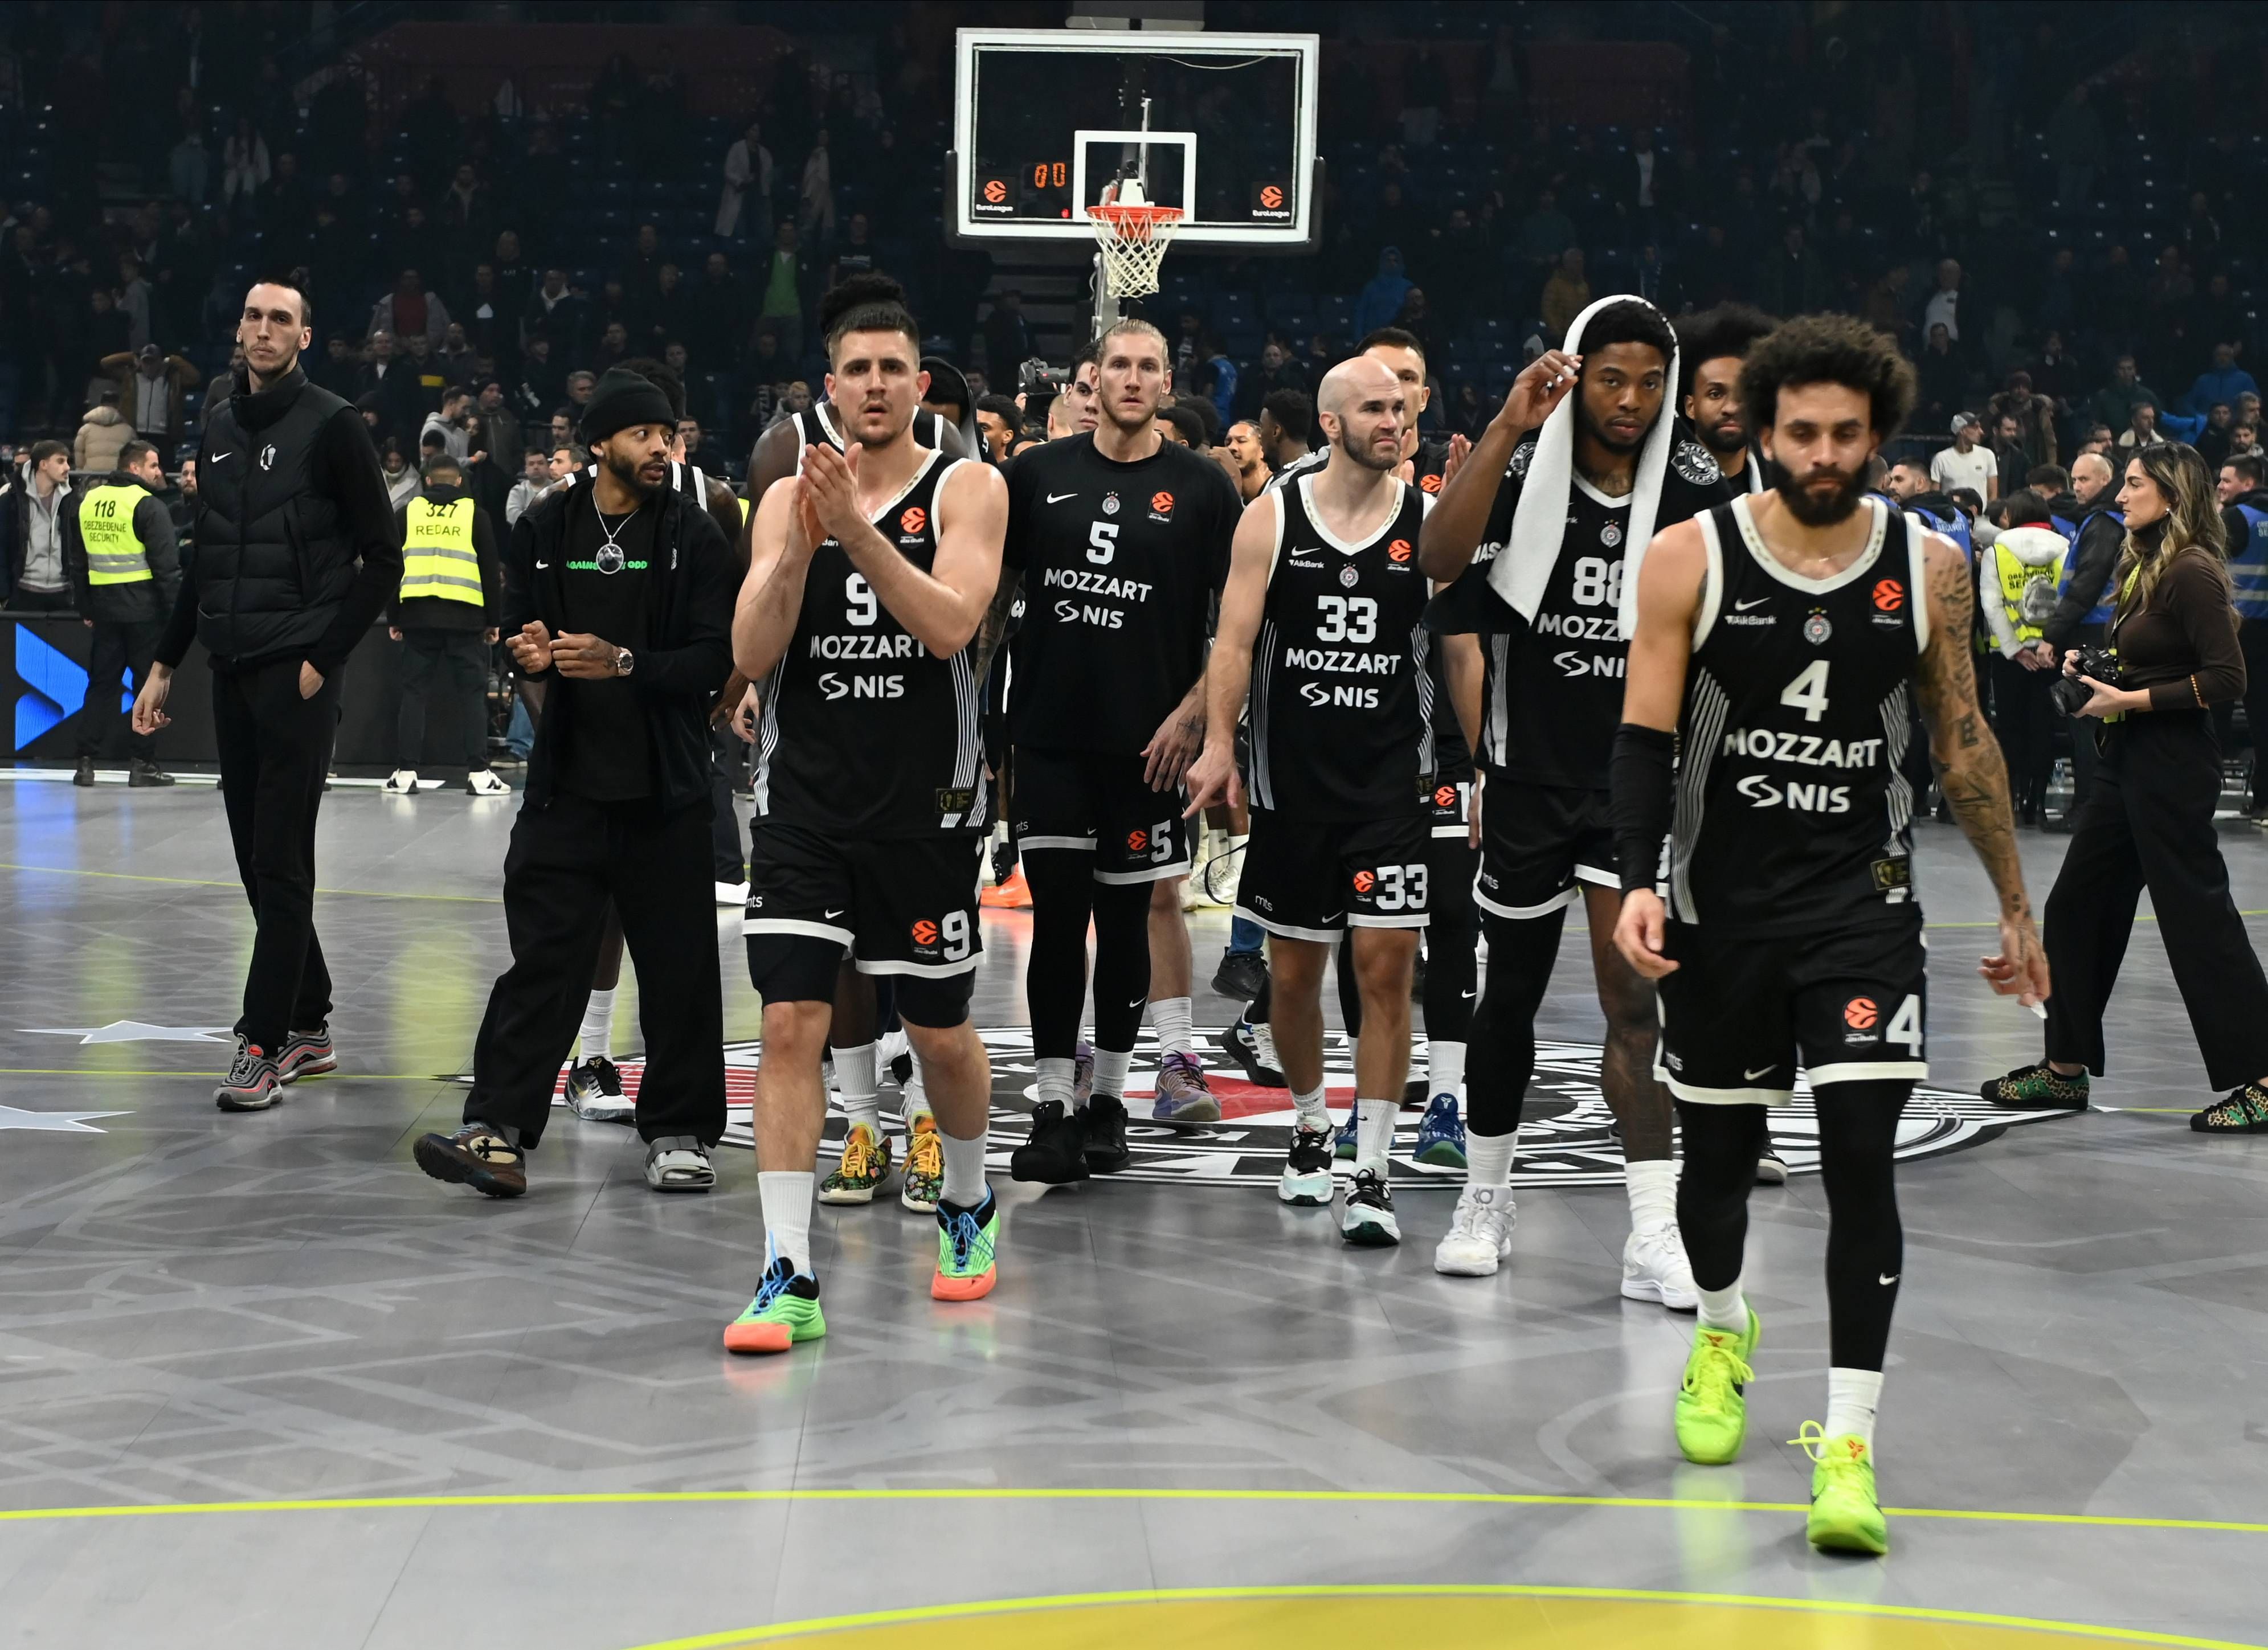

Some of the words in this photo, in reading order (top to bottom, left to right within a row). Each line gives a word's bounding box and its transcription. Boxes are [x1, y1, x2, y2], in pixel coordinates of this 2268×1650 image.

[95, 500, 116, 518] 118
[426, 502, 458, 518] 327
[89, 532, 119, 543] SECURITY
[416, 525, 460, 537] REDAR
[1086, 521, 1119, 564] 5
[566, 560, 598, 570] AGAINS
[846, 572, 878, 626] 9
[1044, 568, 1153, 602] MOZZART
[1083, 605, 1125, 629] NIS
[1317, 595, 1378, 644] 33
[1537, 613, 1625, 642] MOZZ
[810, 635, 925, 659] MOZZART
[1285, 648, 1401, 675] MOZZART
[1593, 655, 1625, 678] NI
[854, 675, 904, 698] NIS
[1334, 686, 1379, 709] NIS
[1780, 660, 1830, 722] 4
[1723, 727, 1883, 768] MOZZART
[1787, 782, 1850, 813] NIS
[1151, 819, 1172, 863] 5
[1376, 863, 1428, 910] 33
[1255, 895, 1273, 911] mts
[942, 909, 970, 961] 9
[1886, 994, 1923, 1057] 4
